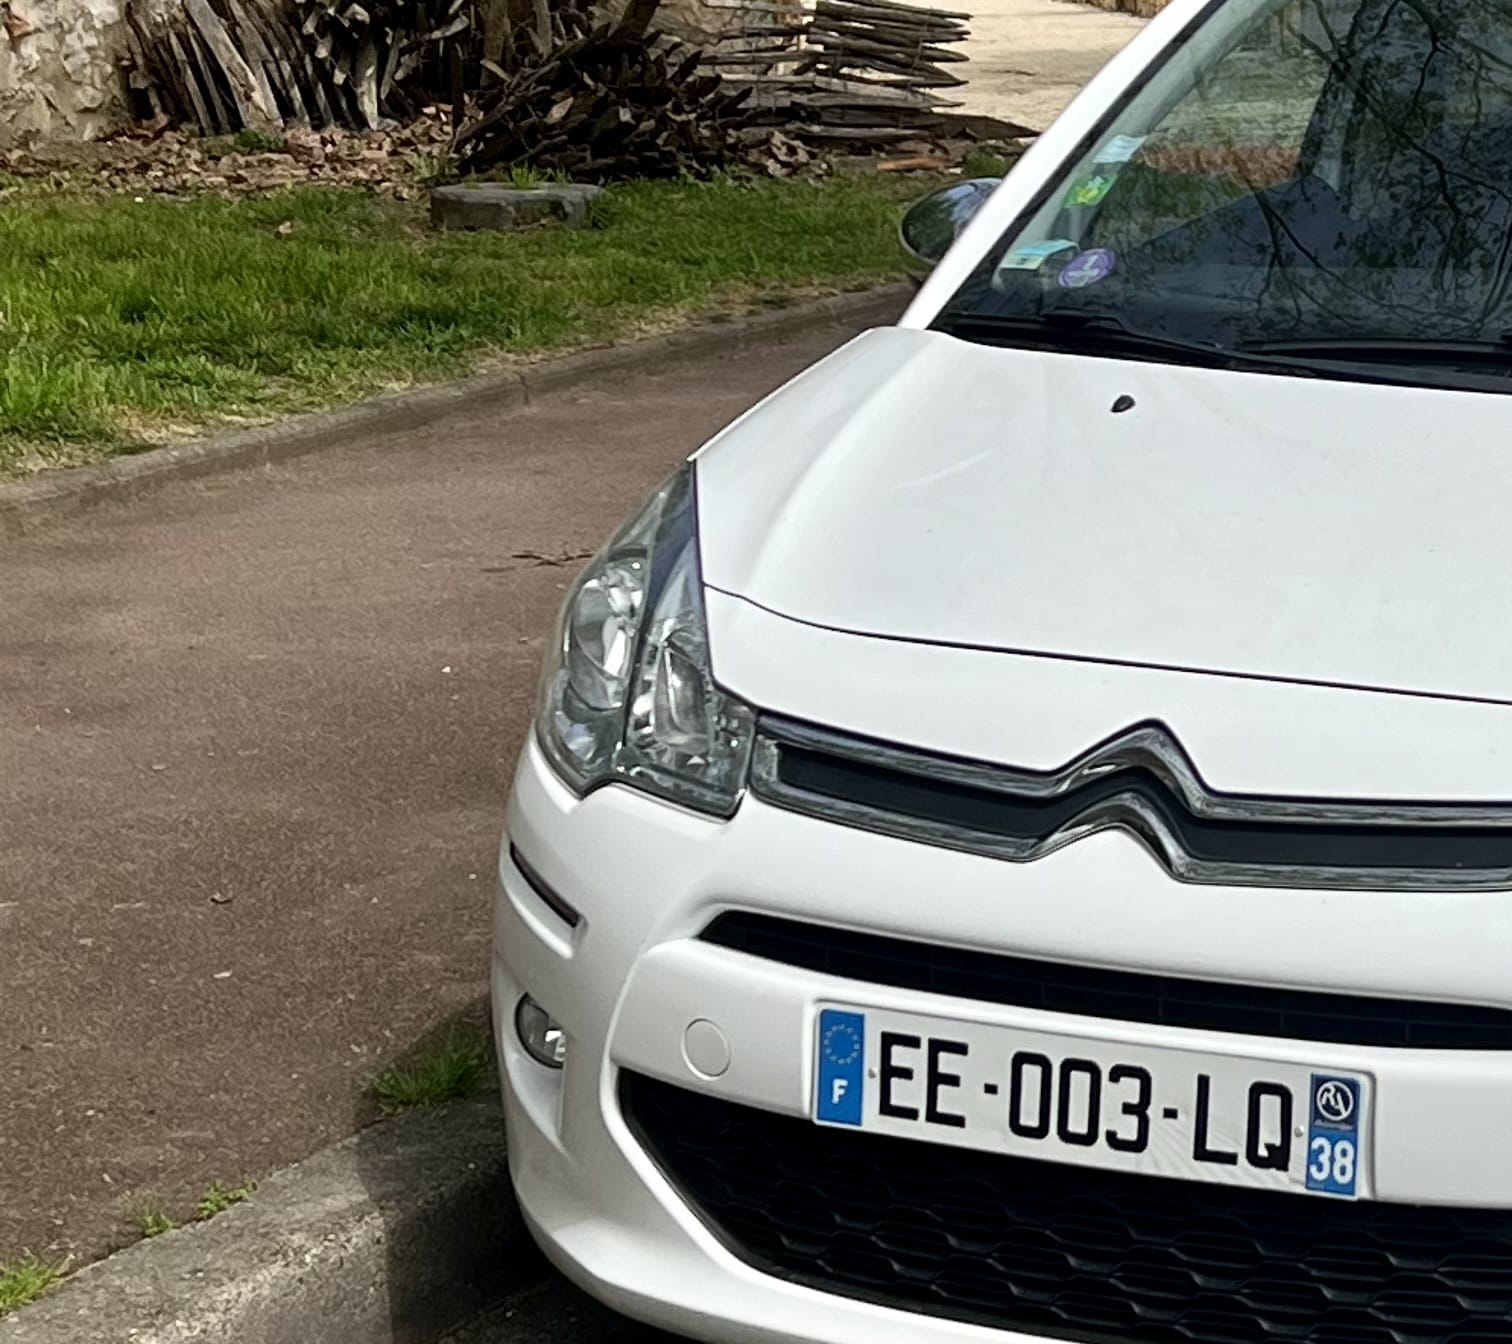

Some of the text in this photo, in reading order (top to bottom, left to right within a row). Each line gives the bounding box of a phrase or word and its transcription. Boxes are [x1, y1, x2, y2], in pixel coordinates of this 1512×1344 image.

[832, 1078, 848, 1104] F
[879, 1031, 1293, 1172] EE-003-LQ
[1309, 1136, 1354, 1184] 38
